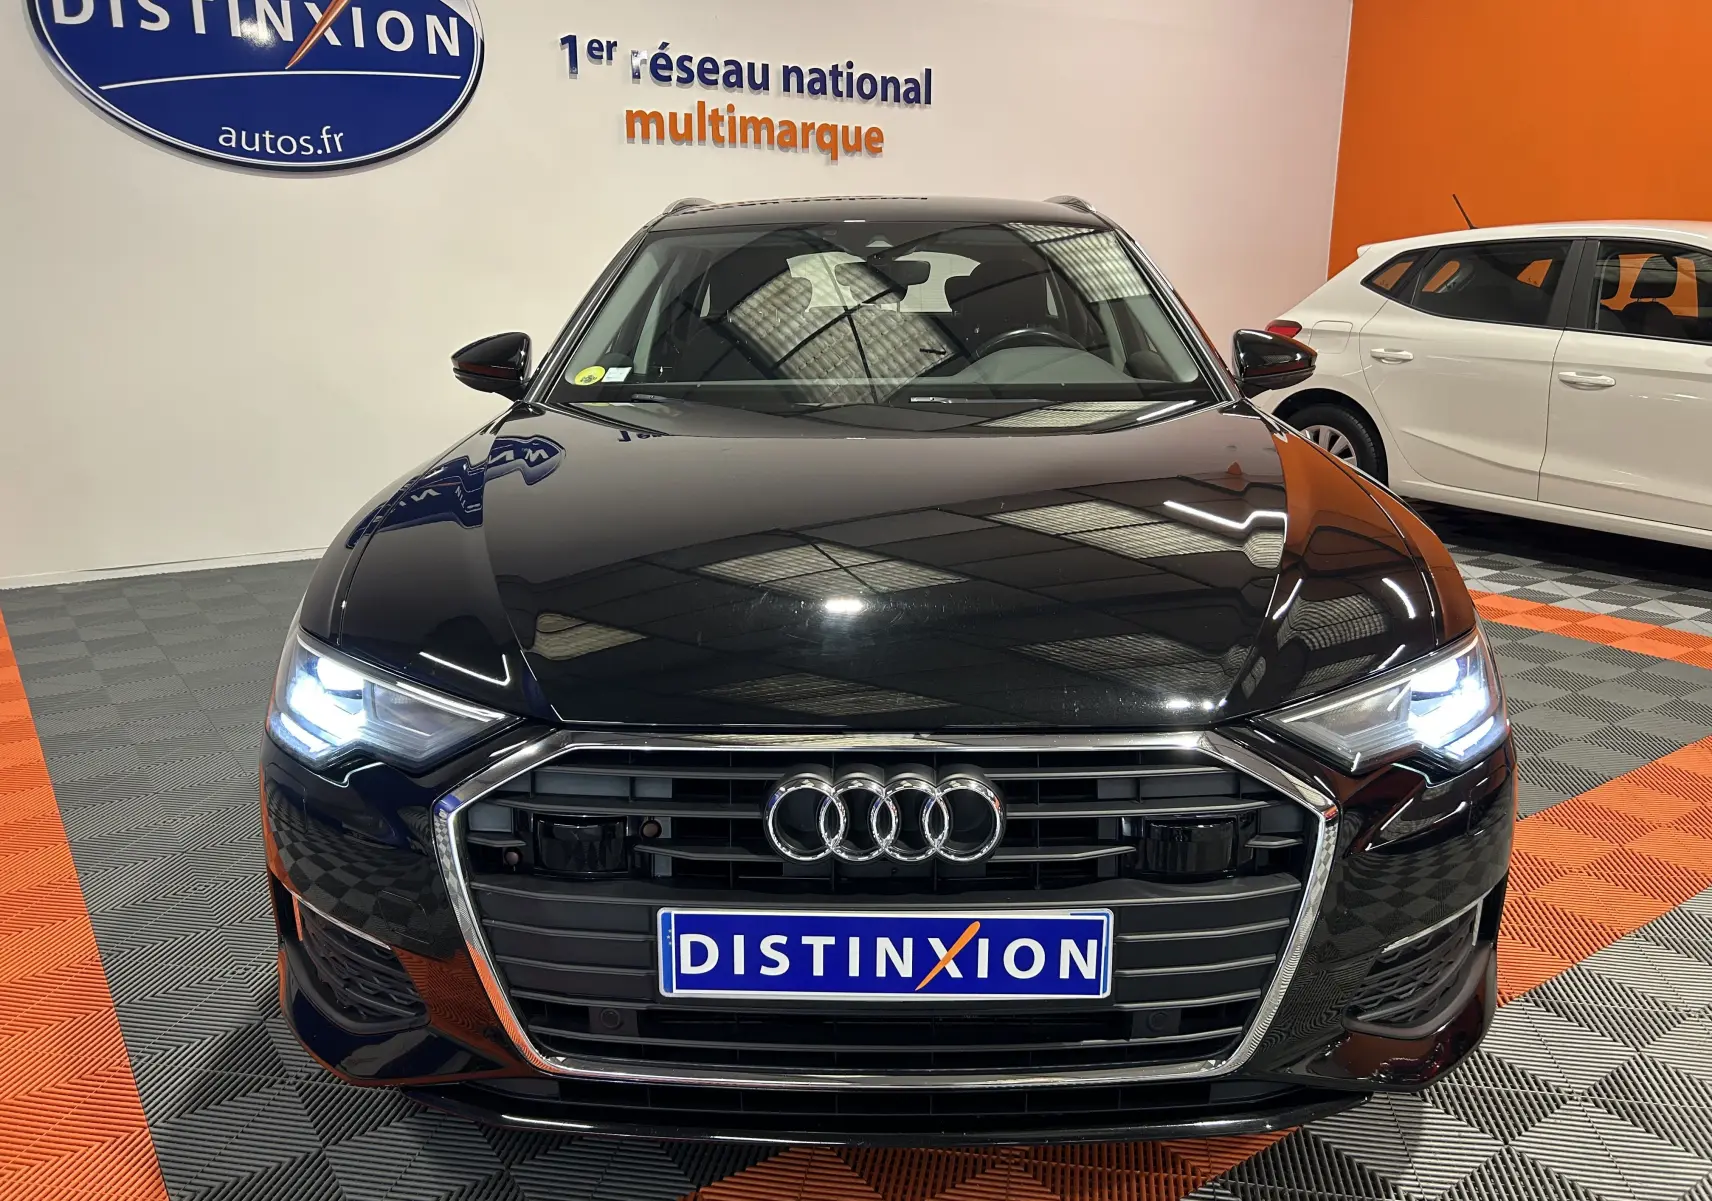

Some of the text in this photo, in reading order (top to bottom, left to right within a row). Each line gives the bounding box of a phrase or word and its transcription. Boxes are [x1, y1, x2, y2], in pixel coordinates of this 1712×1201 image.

[630, 42, 770, 91] réseau
[782, 60, 932, 105] national
[218, 125, 344, 156] autos.fr
[625, 100, 885, 161] multimarque
[679, 921, 1098, 991] DISTINXION
